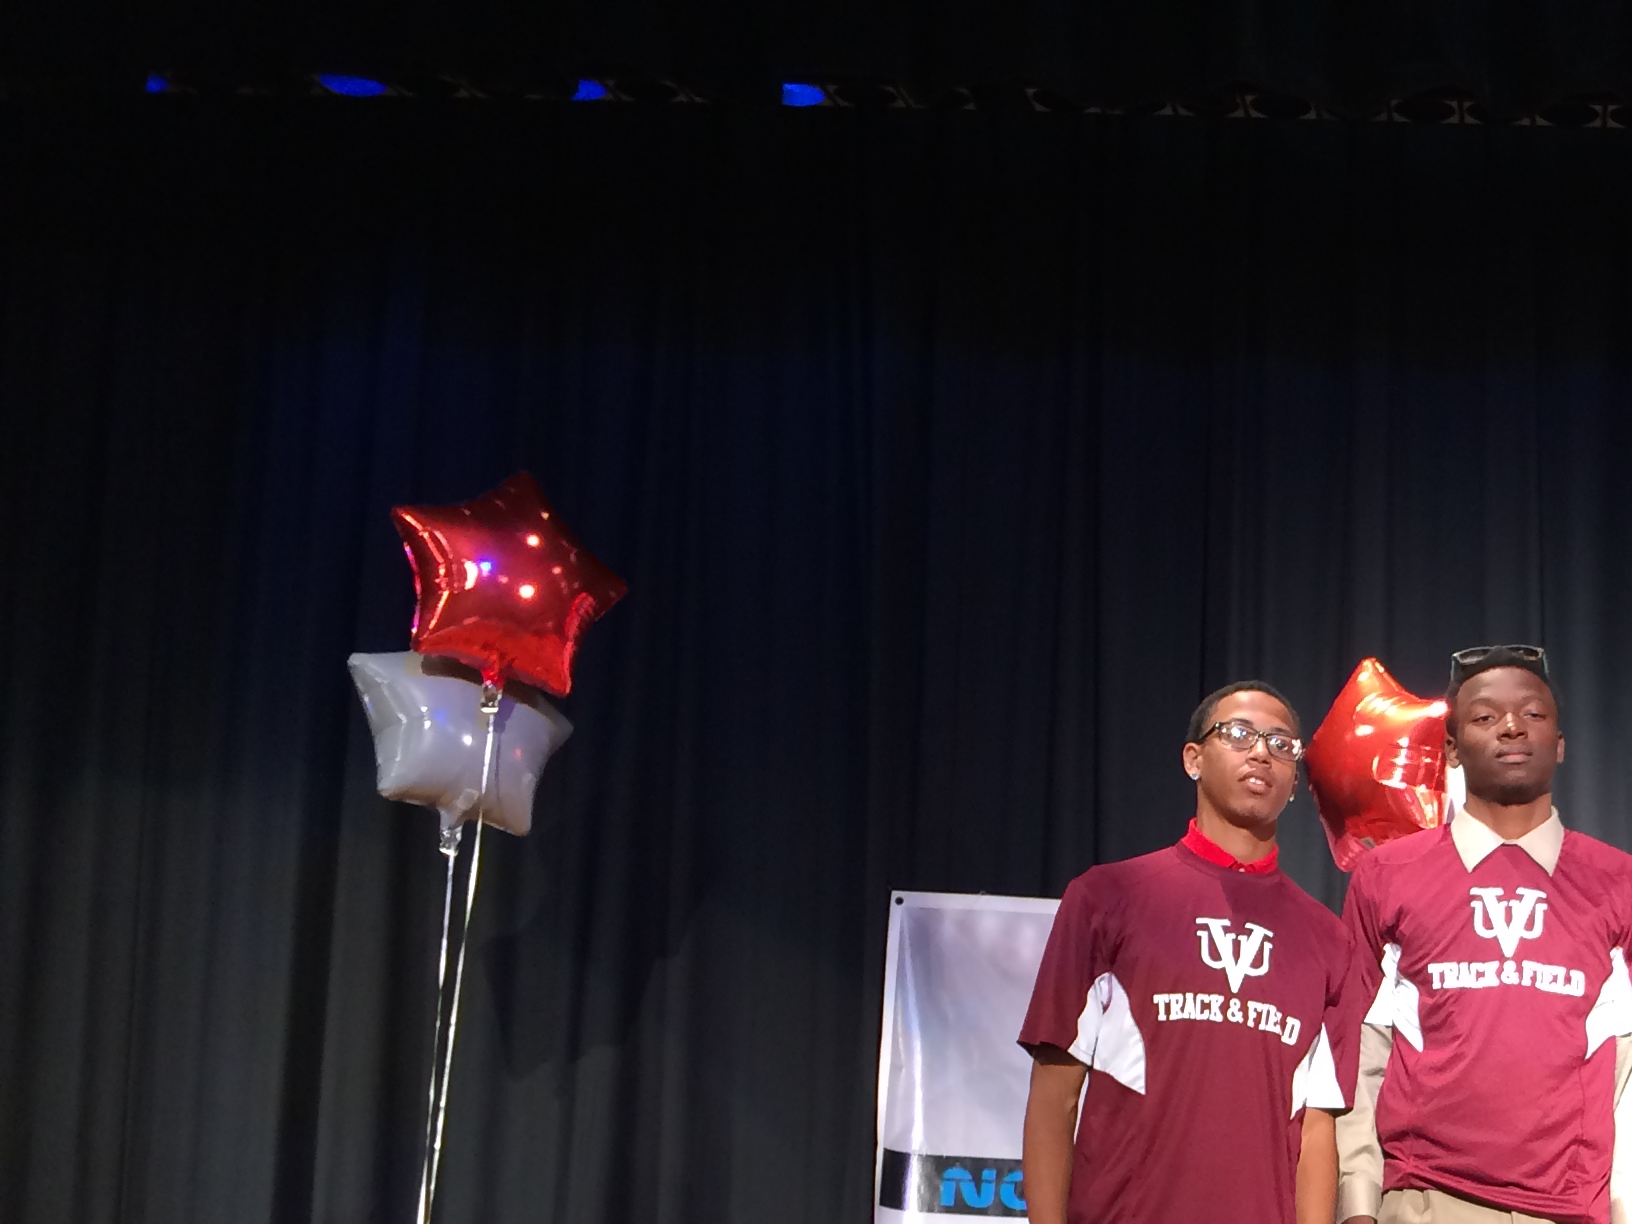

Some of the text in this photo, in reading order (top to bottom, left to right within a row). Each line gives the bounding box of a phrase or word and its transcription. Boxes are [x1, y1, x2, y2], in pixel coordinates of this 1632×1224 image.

[1427, 959, 1585, 997] TRACK & FIELD
[1153, 992, 1301, 1046] TRACK & FIED
